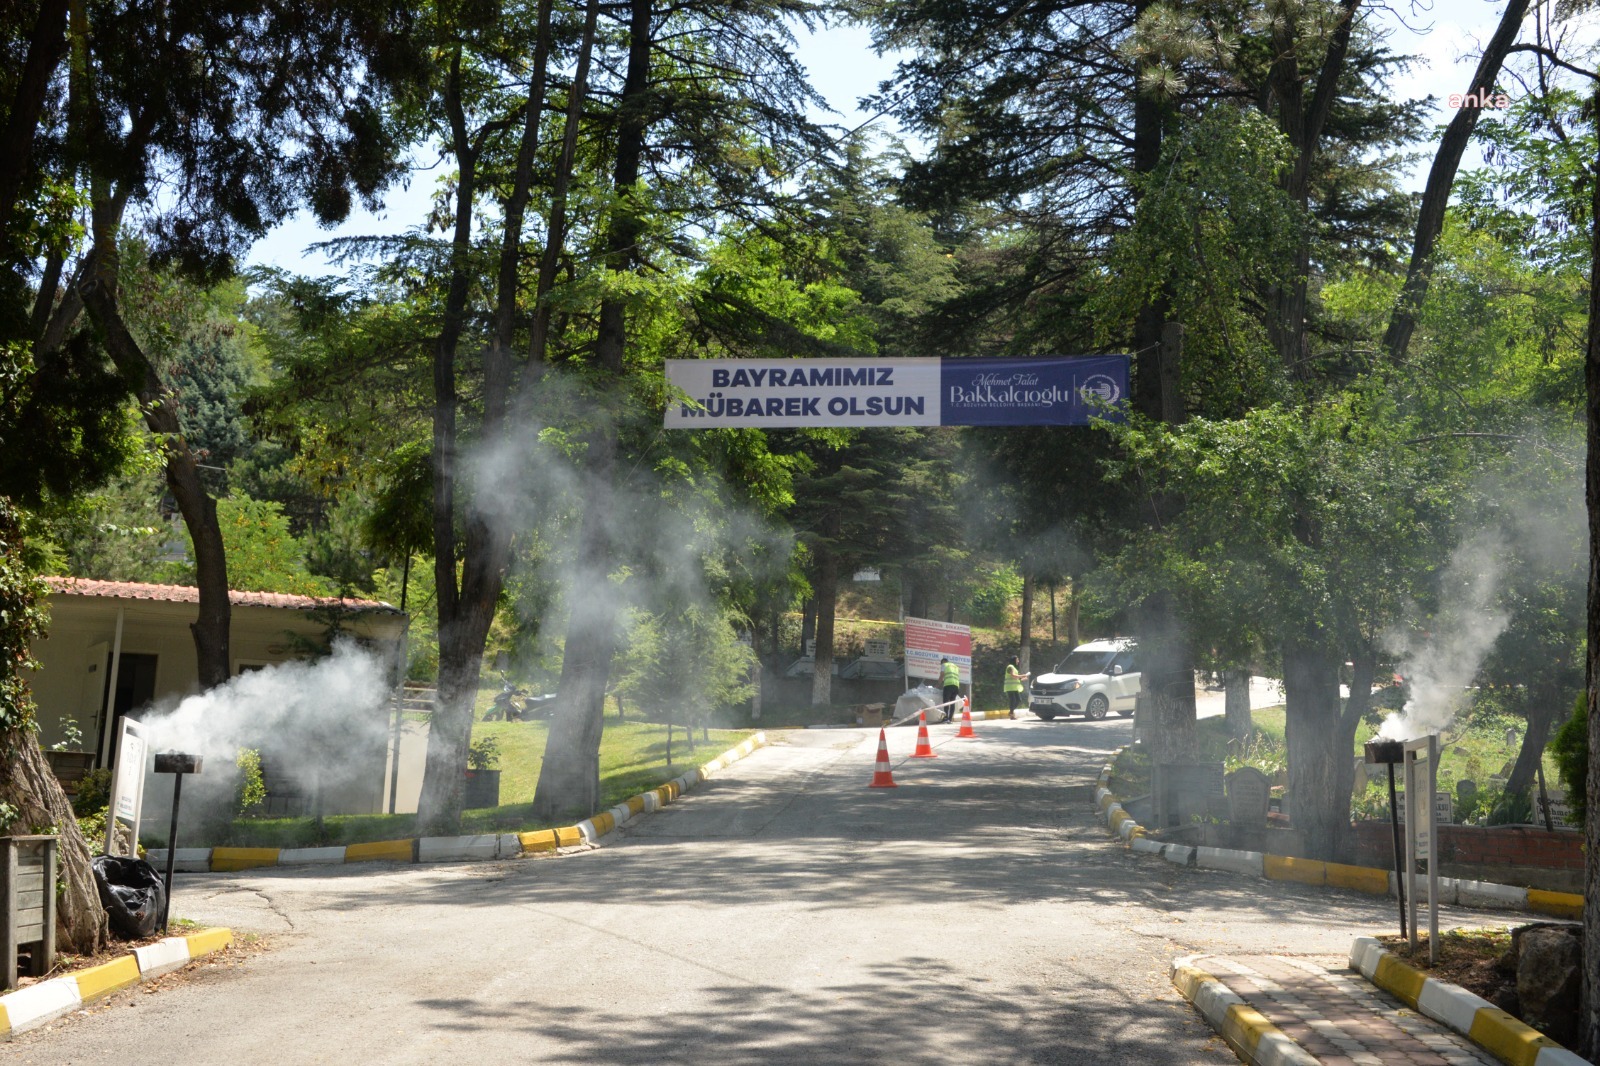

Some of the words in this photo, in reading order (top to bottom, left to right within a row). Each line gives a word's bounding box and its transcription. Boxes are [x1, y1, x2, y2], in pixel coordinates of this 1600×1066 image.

[712, 367, 894, 387] BAYRAMIMIZ
[971, 373, 1012, 388] Mehmet
[1013, 373, 1039, 386] Talat
[681, 392, 821, 418] MÜBAREK
[827, 396, 925, 416] OLSUN
[950, 385, 1069, 408] Bakkalcıoğlu
